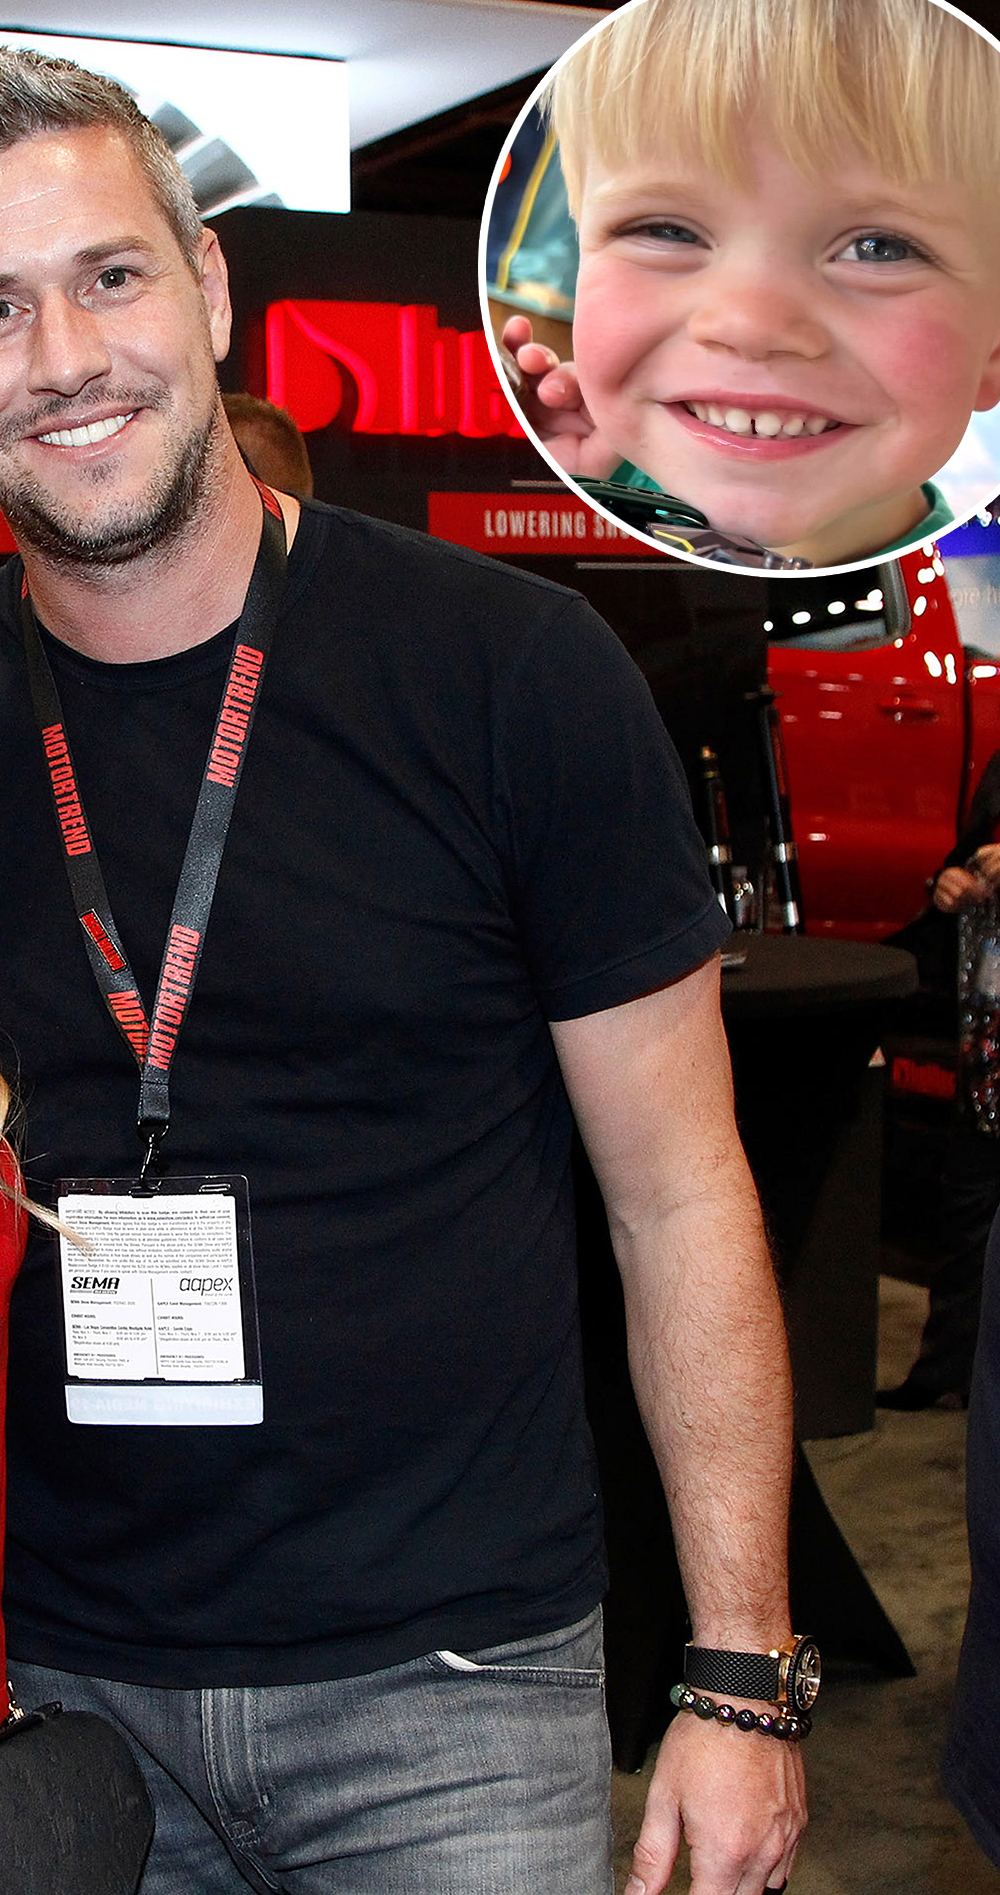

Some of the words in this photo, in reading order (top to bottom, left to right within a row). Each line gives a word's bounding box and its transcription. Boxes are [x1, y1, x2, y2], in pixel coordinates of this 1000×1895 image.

[484, 509, 586, 539] LOWERING
[206, 644, 265, 788] MOTORTREND
[41, 723, 92, 856] MOTORTREND
[147, 924, 201, 1071] MOTORTREND
[70, 1276, 121, 1290] SEMA
[179, 1277, 234, 1296] aapex
